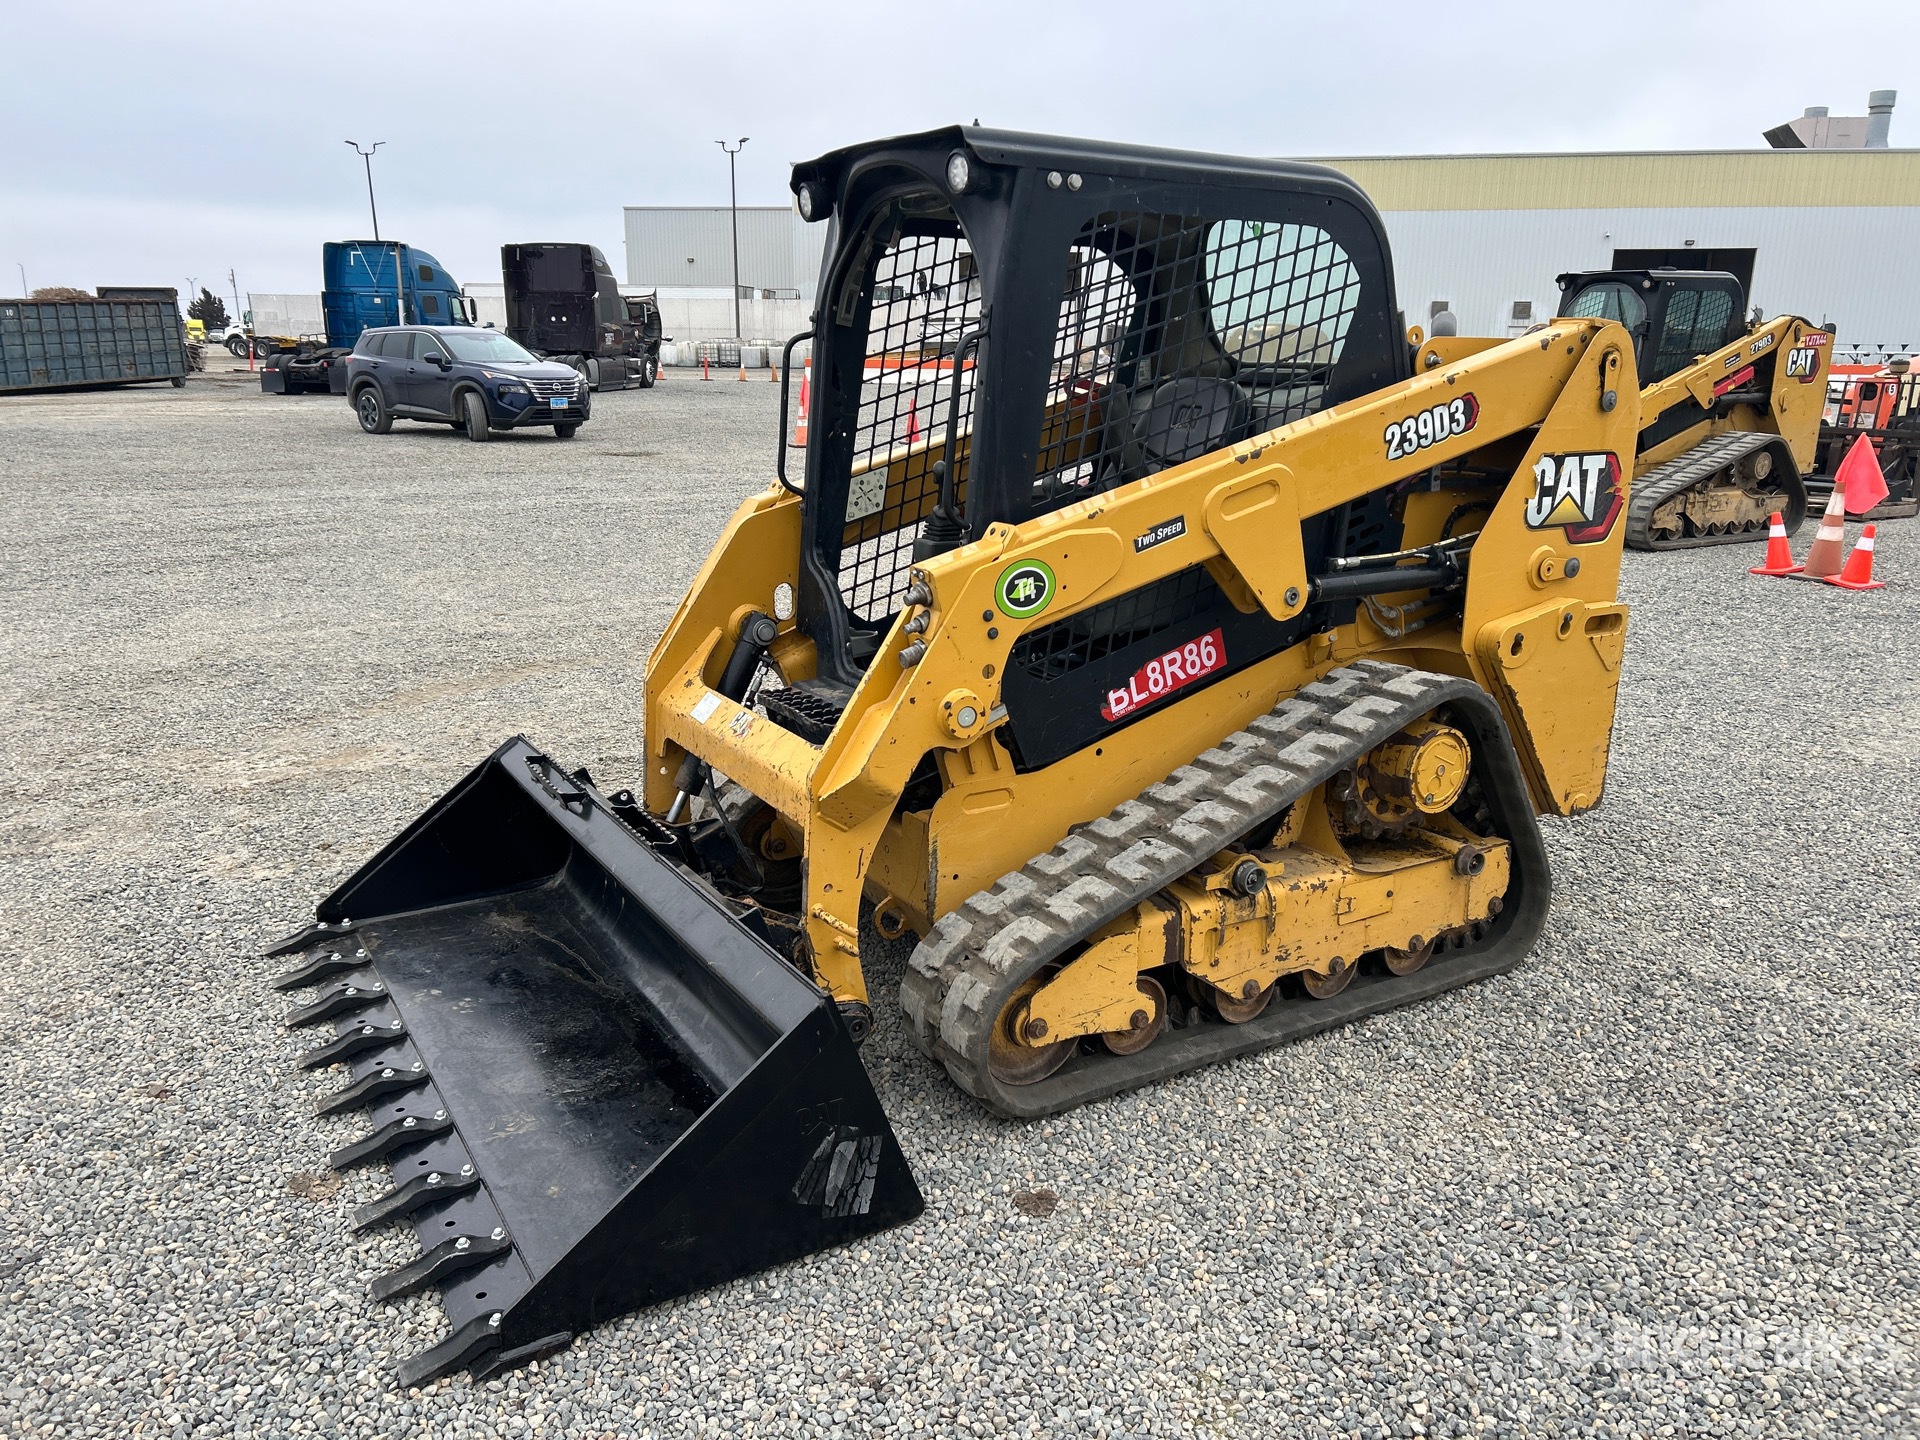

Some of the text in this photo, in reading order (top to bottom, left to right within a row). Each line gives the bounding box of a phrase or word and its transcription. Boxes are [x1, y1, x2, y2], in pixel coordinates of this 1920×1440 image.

[1750, 335, 1772, 354] 279D3
[1787, 349, 1815, 376] CAT
[1385, 397, 1466, 460] 239D3
[1526, 453, 1607, 527] CAT
[1107, 634, 1217, 715] BL8R86
